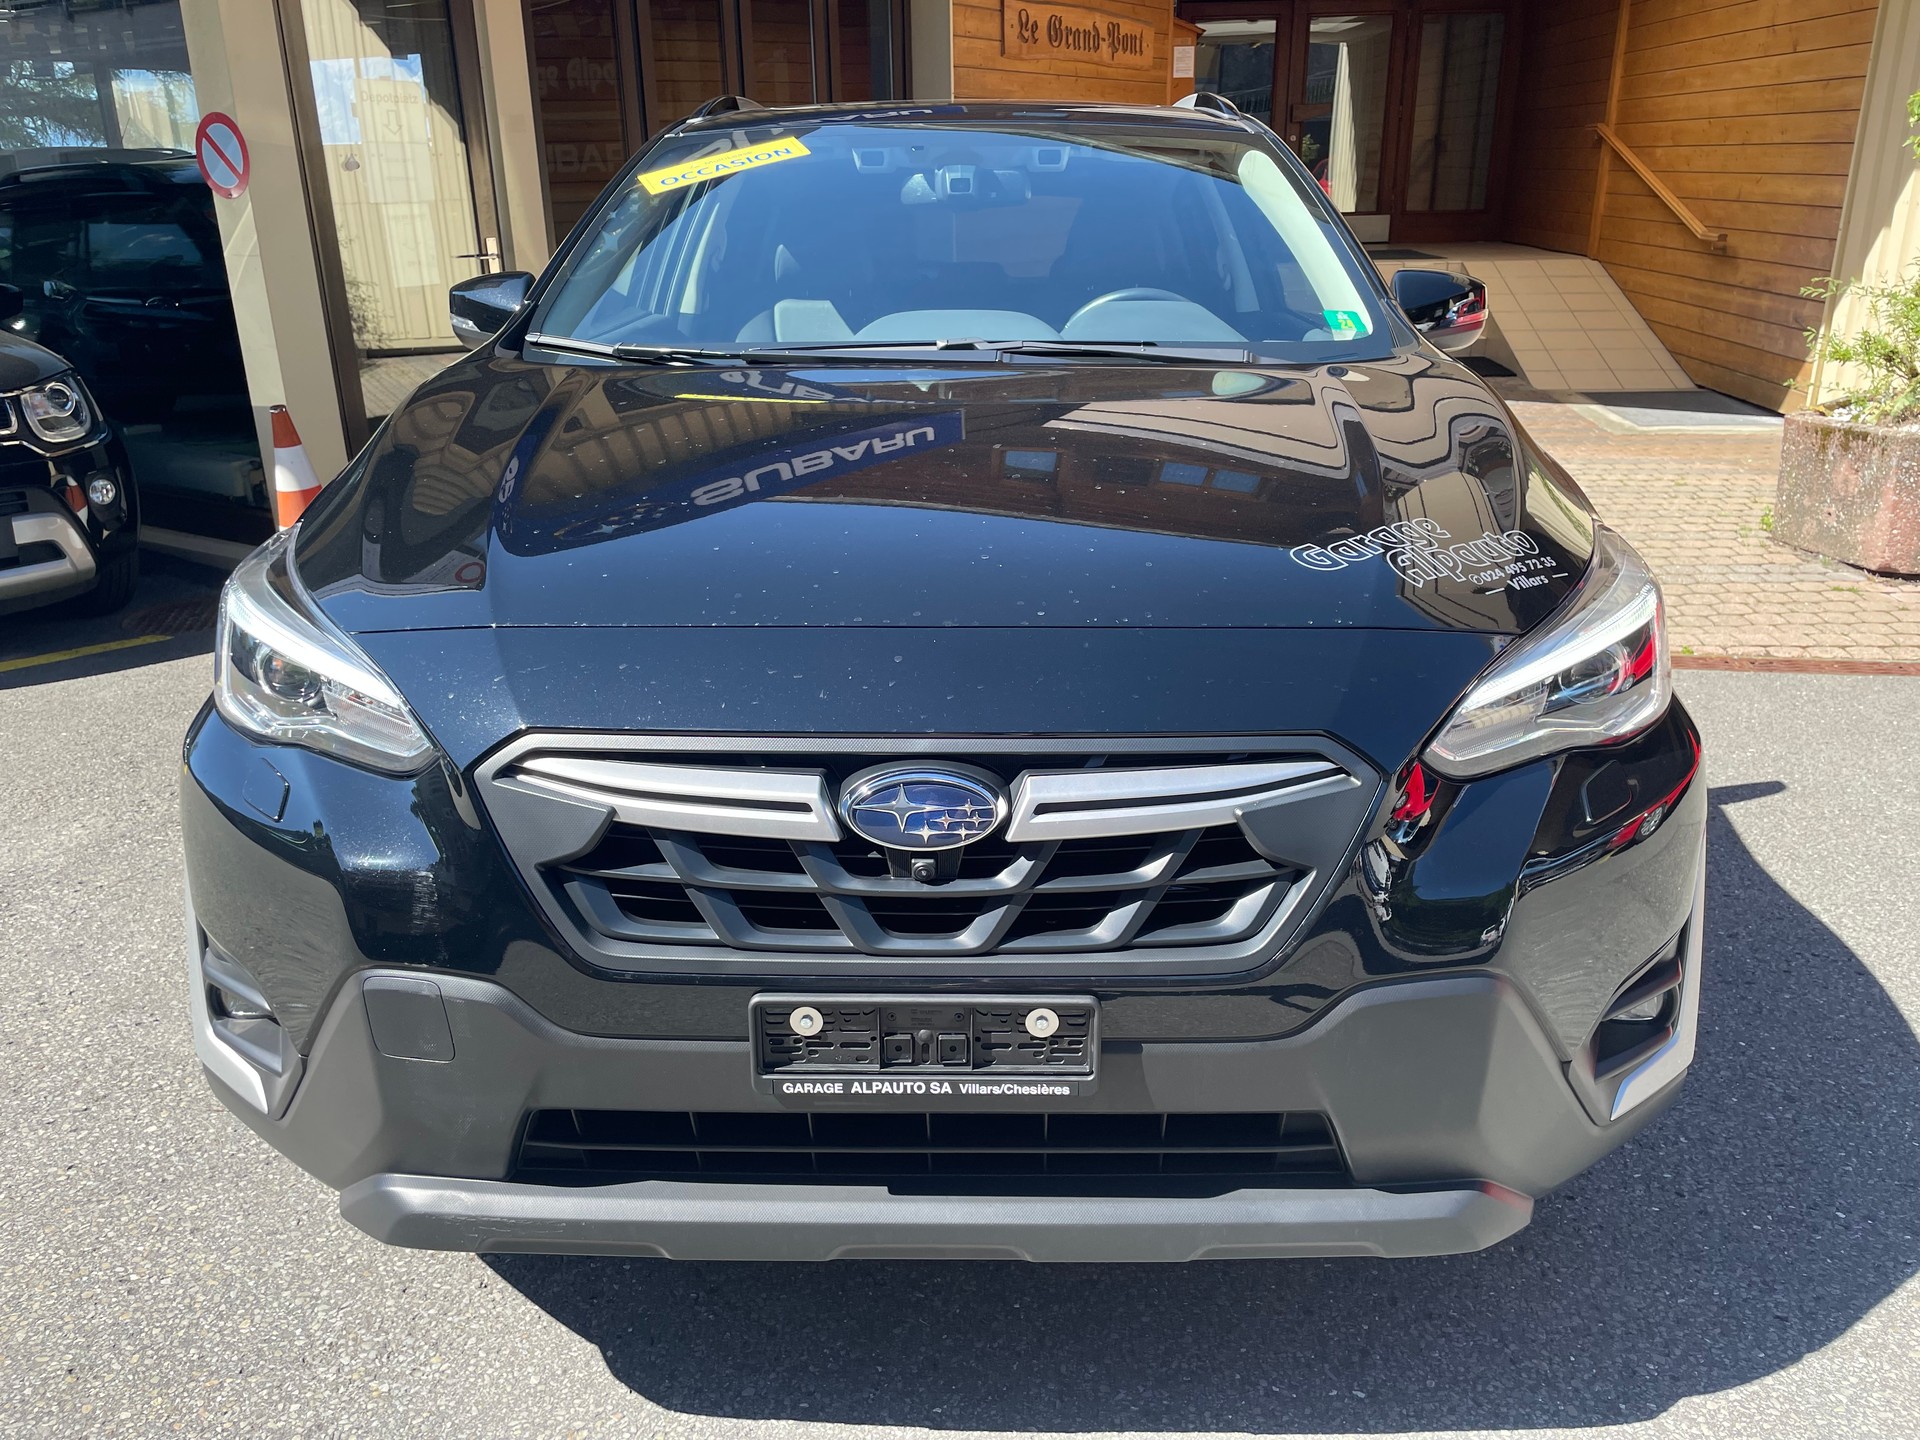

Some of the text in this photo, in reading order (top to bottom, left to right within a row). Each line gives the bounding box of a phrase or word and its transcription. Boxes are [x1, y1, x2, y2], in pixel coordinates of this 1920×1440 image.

[1017, 8, 1144, 61] Le Grand-Pont
[660, 148, 793, 186] OCCASION
[1290, 517, 1451, 571] Garage
[1386, 530, 1539, 588] Alpauto
[1480, 556, 1557, 582] 024 495 72 35
[1507, 574, 1549, 591] Villars
[782, 1081, 1070, 1096] GARAGE ALPAUTO SA Villars/Chesières
